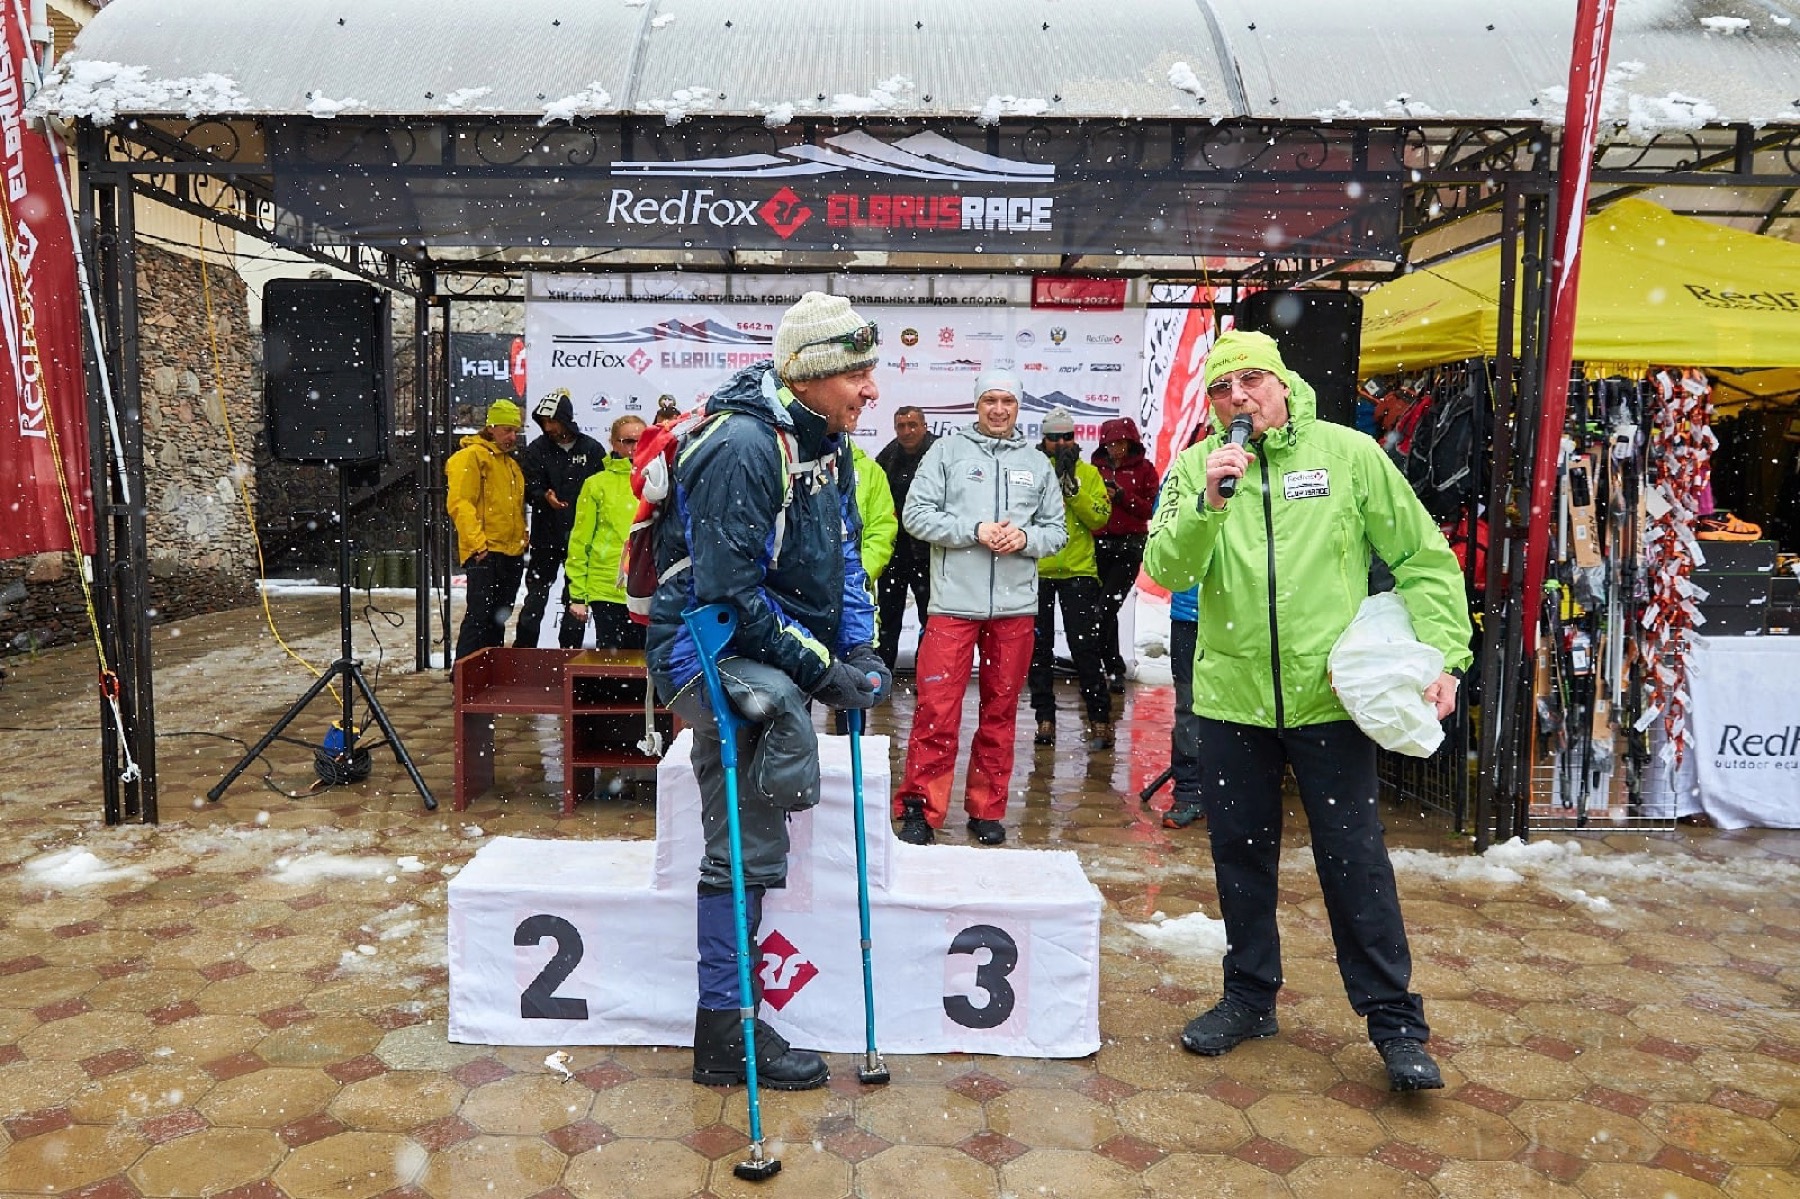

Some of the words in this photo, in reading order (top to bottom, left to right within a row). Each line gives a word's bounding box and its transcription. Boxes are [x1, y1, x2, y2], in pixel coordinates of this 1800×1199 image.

[605, 189, 760, 226] RedFox
[827, 193, 1053, 231] ELBRUSRACE
[762, 293, 803, 304] горны
[918, 295, 958, 306] видов
[961, 296, 1008, 307] спорта
[736, 322, 761, 331] 5642
[551, 349, 626, 368] RedFox
[512, 913, 590, 1020] 2
[942, 923, 1019, 1029] 3
